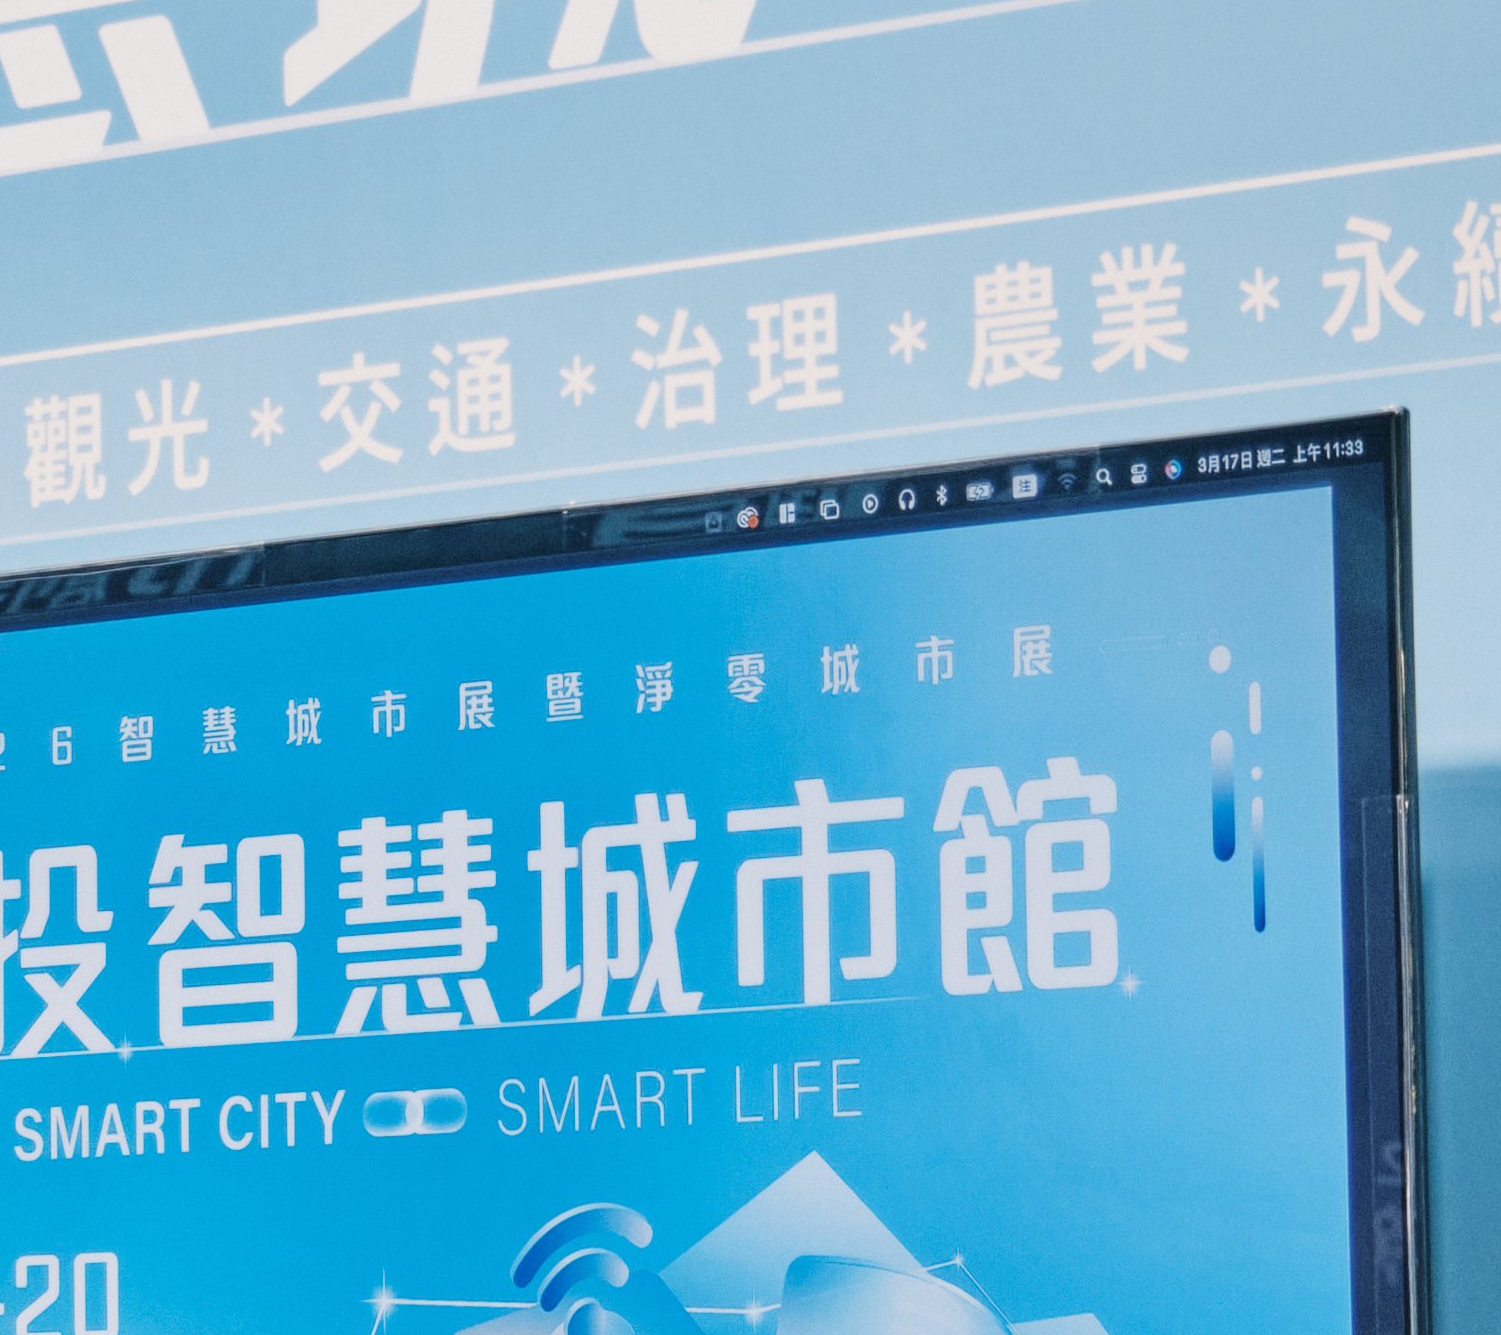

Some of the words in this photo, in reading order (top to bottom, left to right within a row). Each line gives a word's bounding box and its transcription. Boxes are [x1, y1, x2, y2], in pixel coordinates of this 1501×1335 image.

[23, 379, 211, 511] 觀光
[317, 335, 517, 473] 交通
[630, 294, 845, 433] 治理
[967, 243, 1192, 392] 農業
[1197, 449, 1254, 474] 3月17日
[1292, 439, 1365, 465] 上午11:33
[13, 1096, 202, 1162] SMART
[219, 1089, 346, 1152] CITY
[497, 1066, 708, 1136] SMART
[736, 1058, 863, 1124] LIFE
